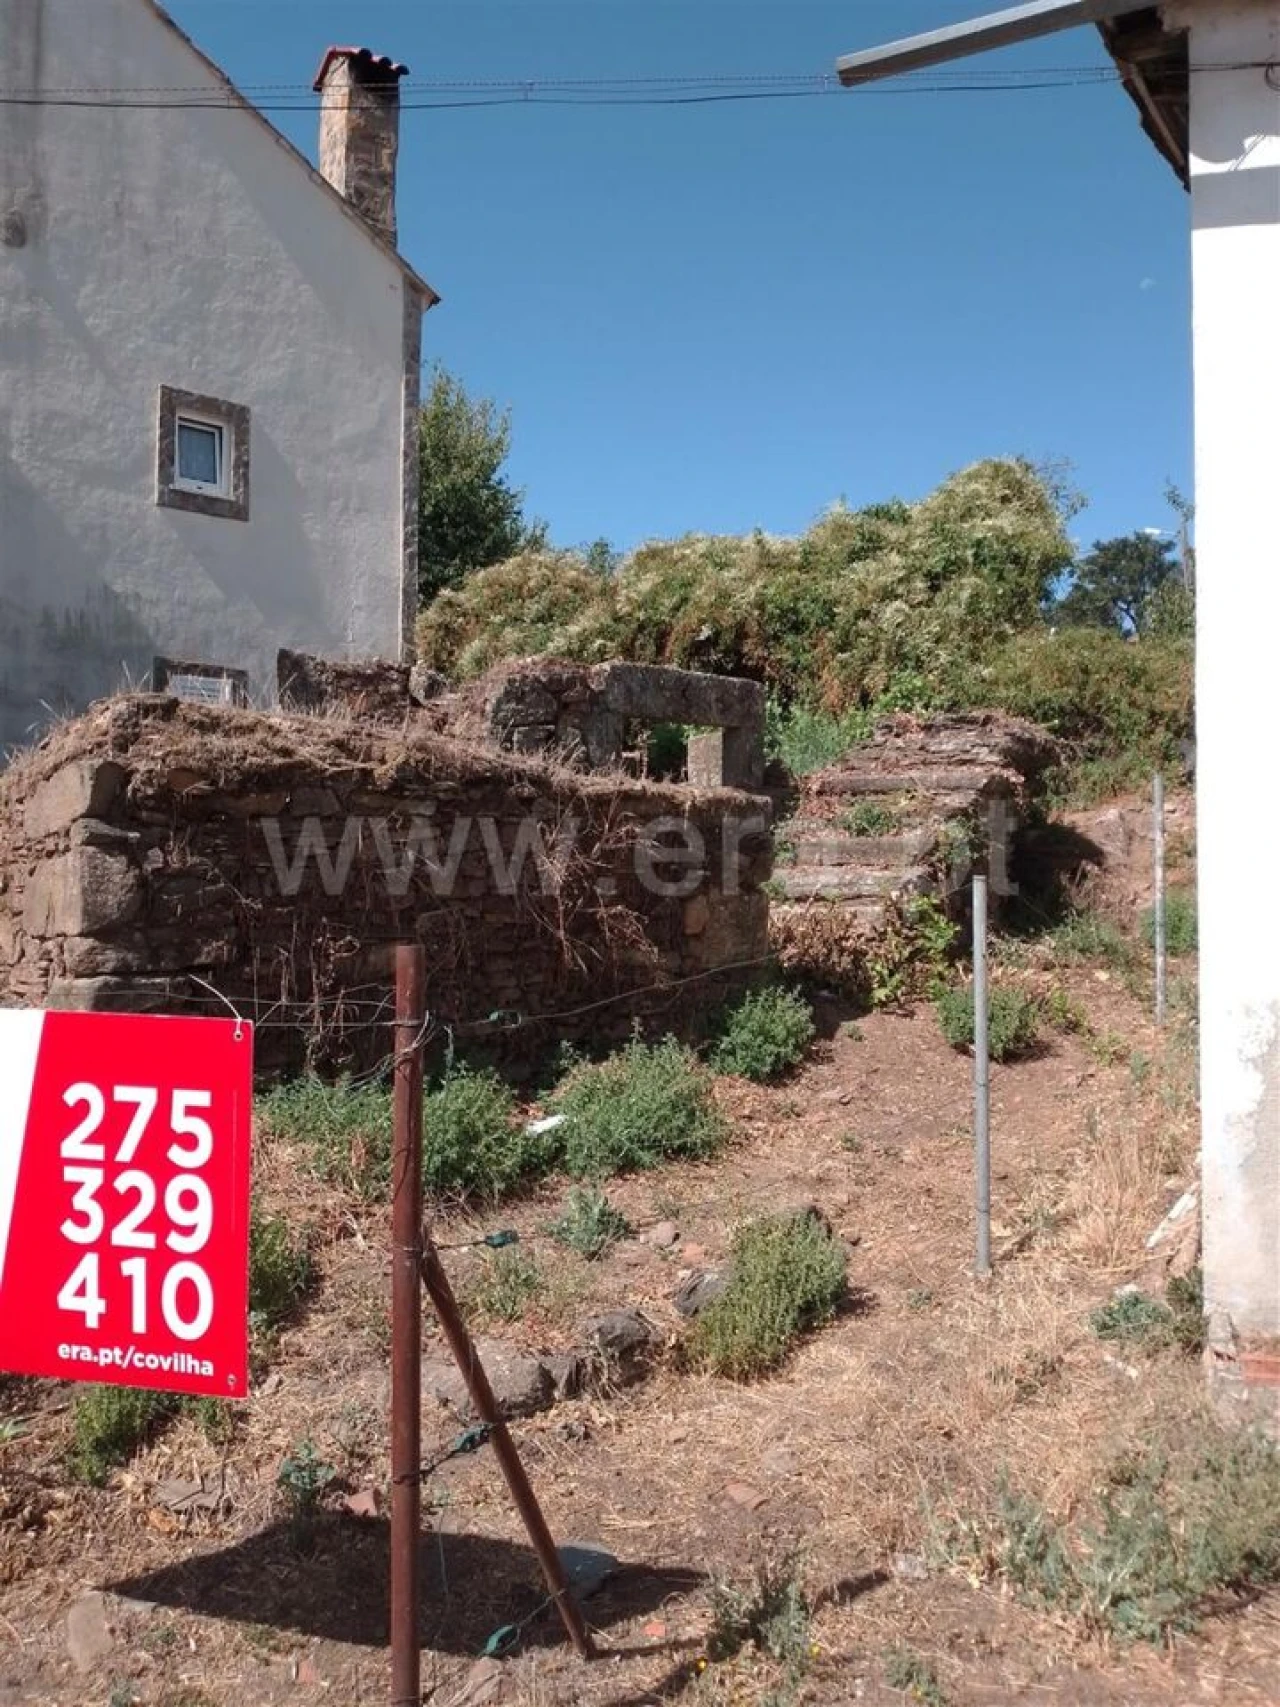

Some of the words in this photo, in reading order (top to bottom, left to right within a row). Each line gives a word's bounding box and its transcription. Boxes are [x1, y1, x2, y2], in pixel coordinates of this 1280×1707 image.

[60, 1082, 213, 1169] 275
[60, 1166, 213, 1253] 329
[57, 1252, 214, 1341] 410
[58, 1342, 214, 1377] era.pt/covilha
